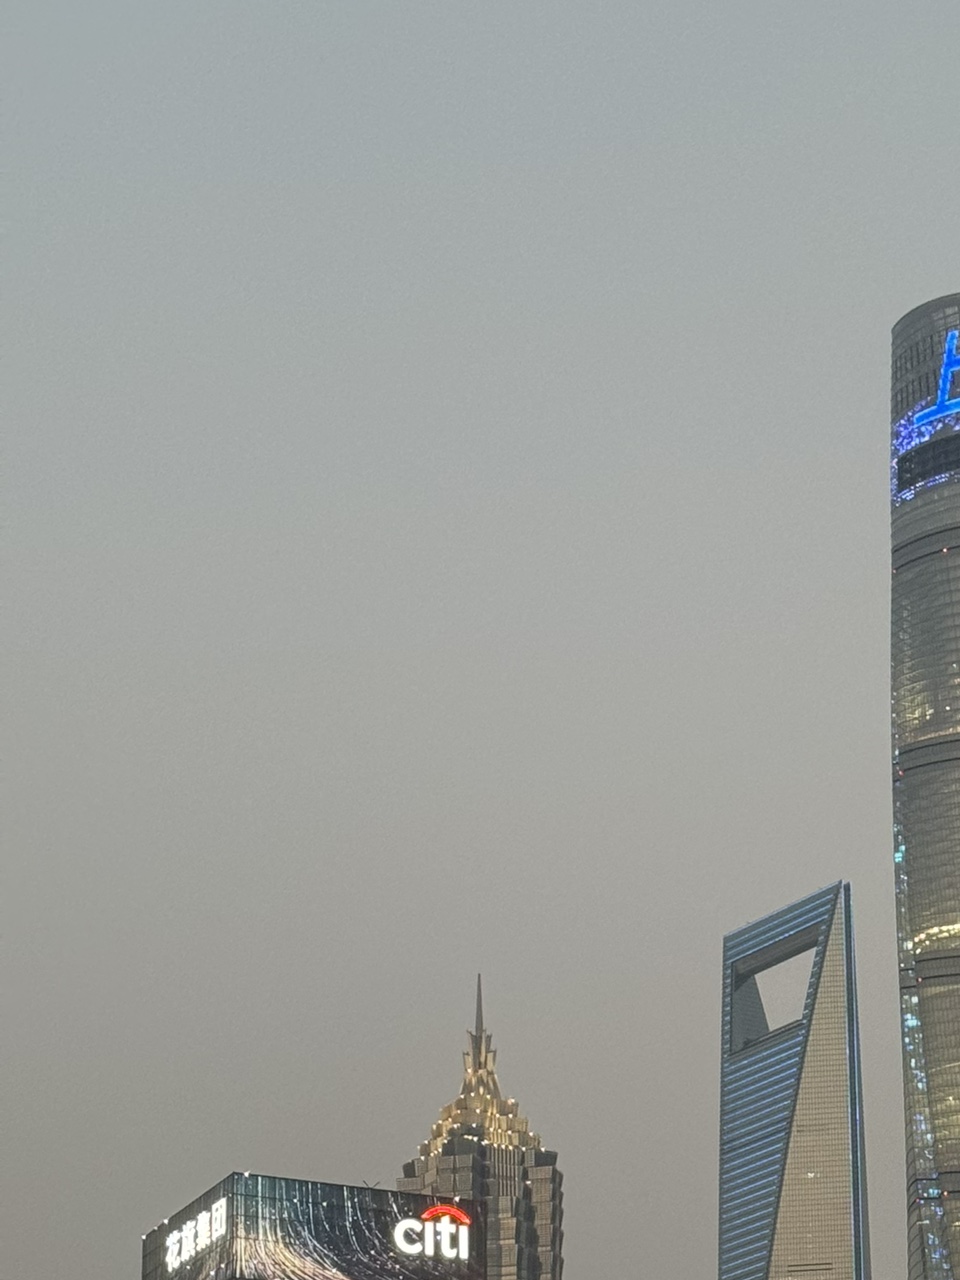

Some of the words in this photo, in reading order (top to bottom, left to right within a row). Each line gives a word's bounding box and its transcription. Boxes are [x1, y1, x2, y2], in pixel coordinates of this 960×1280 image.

[166, 1197, 227, 1273] 花旗集团
[393, 1212, 470, 1260] citi
